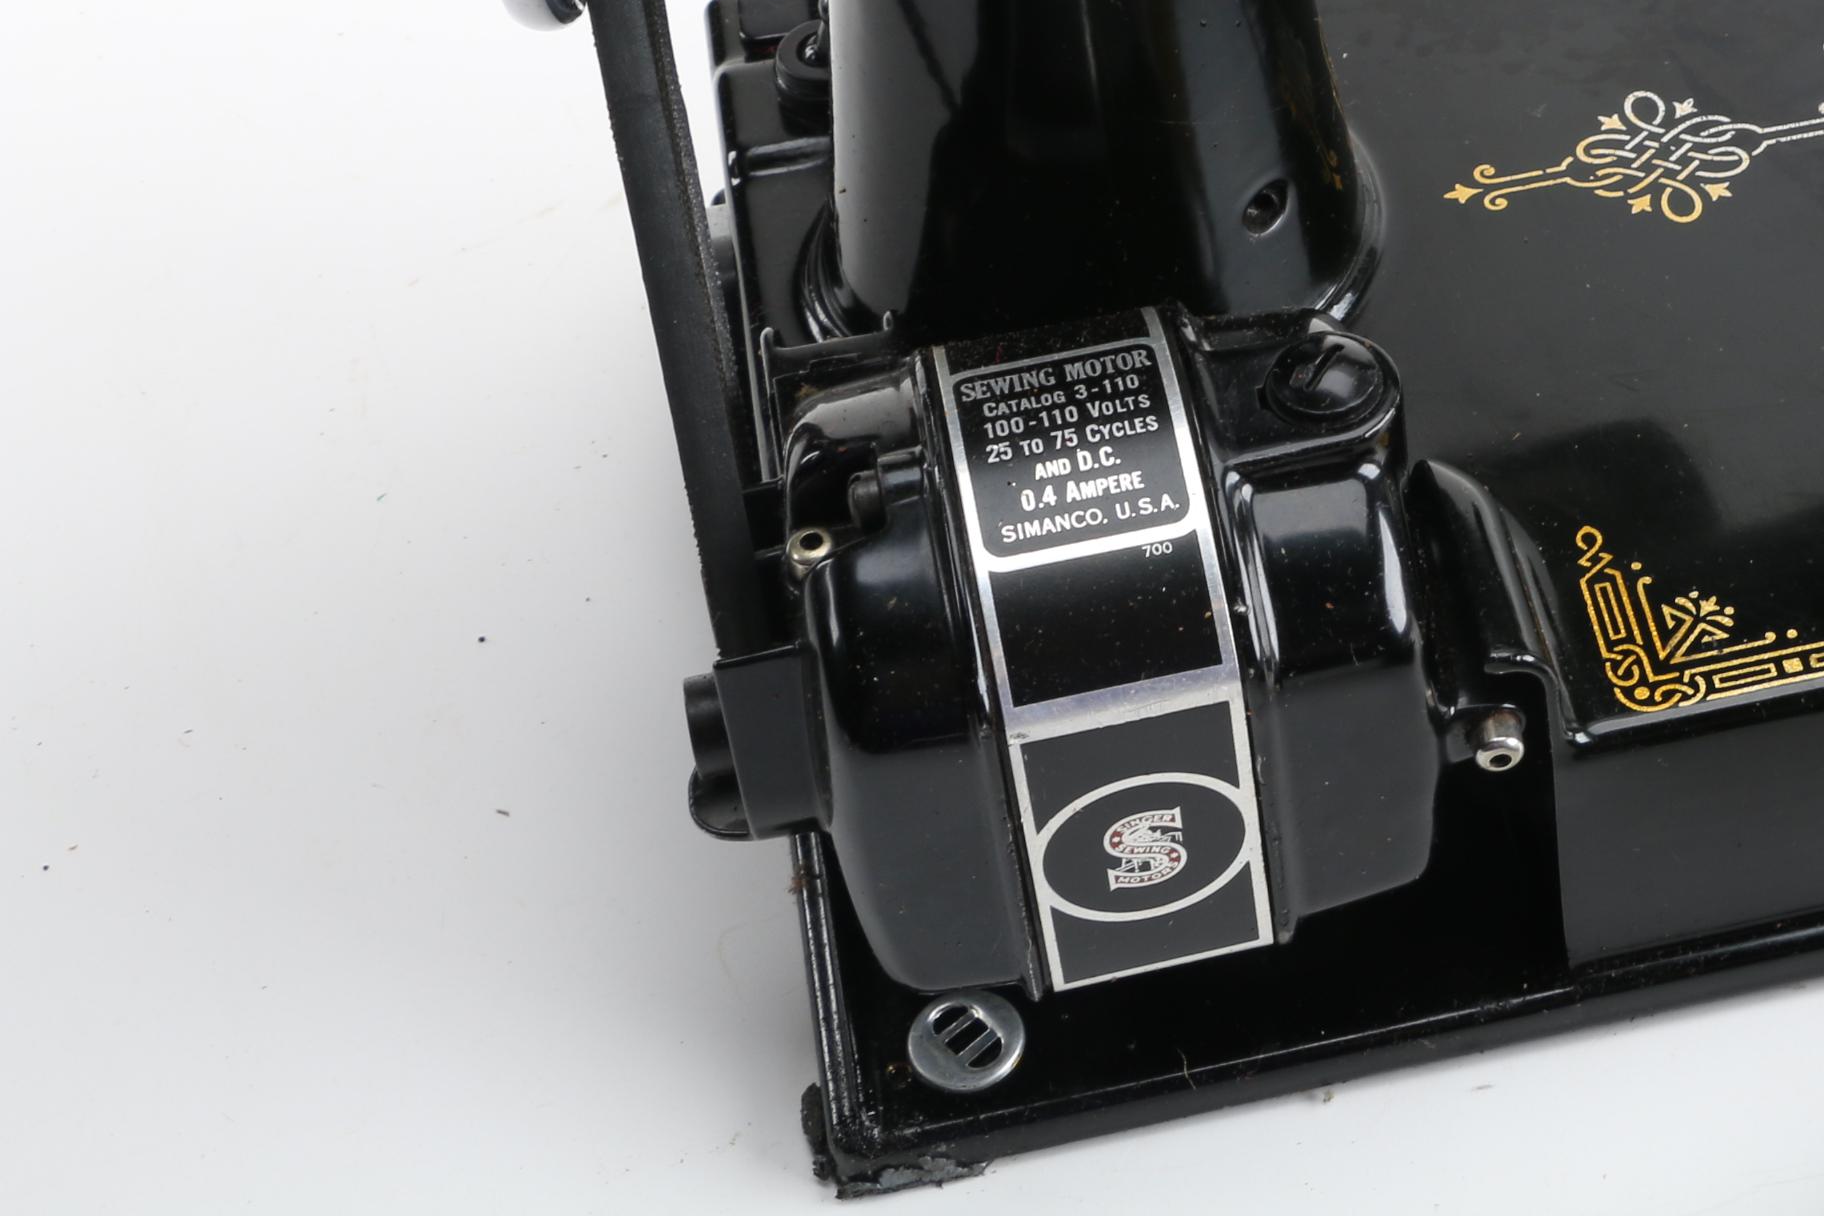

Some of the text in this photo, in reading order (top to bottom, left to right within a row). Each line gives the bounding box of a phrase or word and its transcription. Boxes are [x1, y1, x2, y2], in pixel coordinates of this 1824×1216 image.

[961, 349, 1152, 402] SEWING MOTOR
[983, 374, 1140, 418] CATALOG 3-110
[984, 394, 1150, 439] 100-110 VOLTS
[986, 415, 1159, 463] 25 TO 75 CYCLES
[1035, 446, 1121, 481] AND D.C.
[1021, 471, 1144, 511] 0.4 AMPERE
[1115, 493, 1180, 519] U.S.A.
[1142, 541, 1173, 558] 700
[1115, 814, 1174, 832] SINGER
[1117, 845, 1170, 854] SEWING
[1118, 862, 1179, 884] MOTORS
